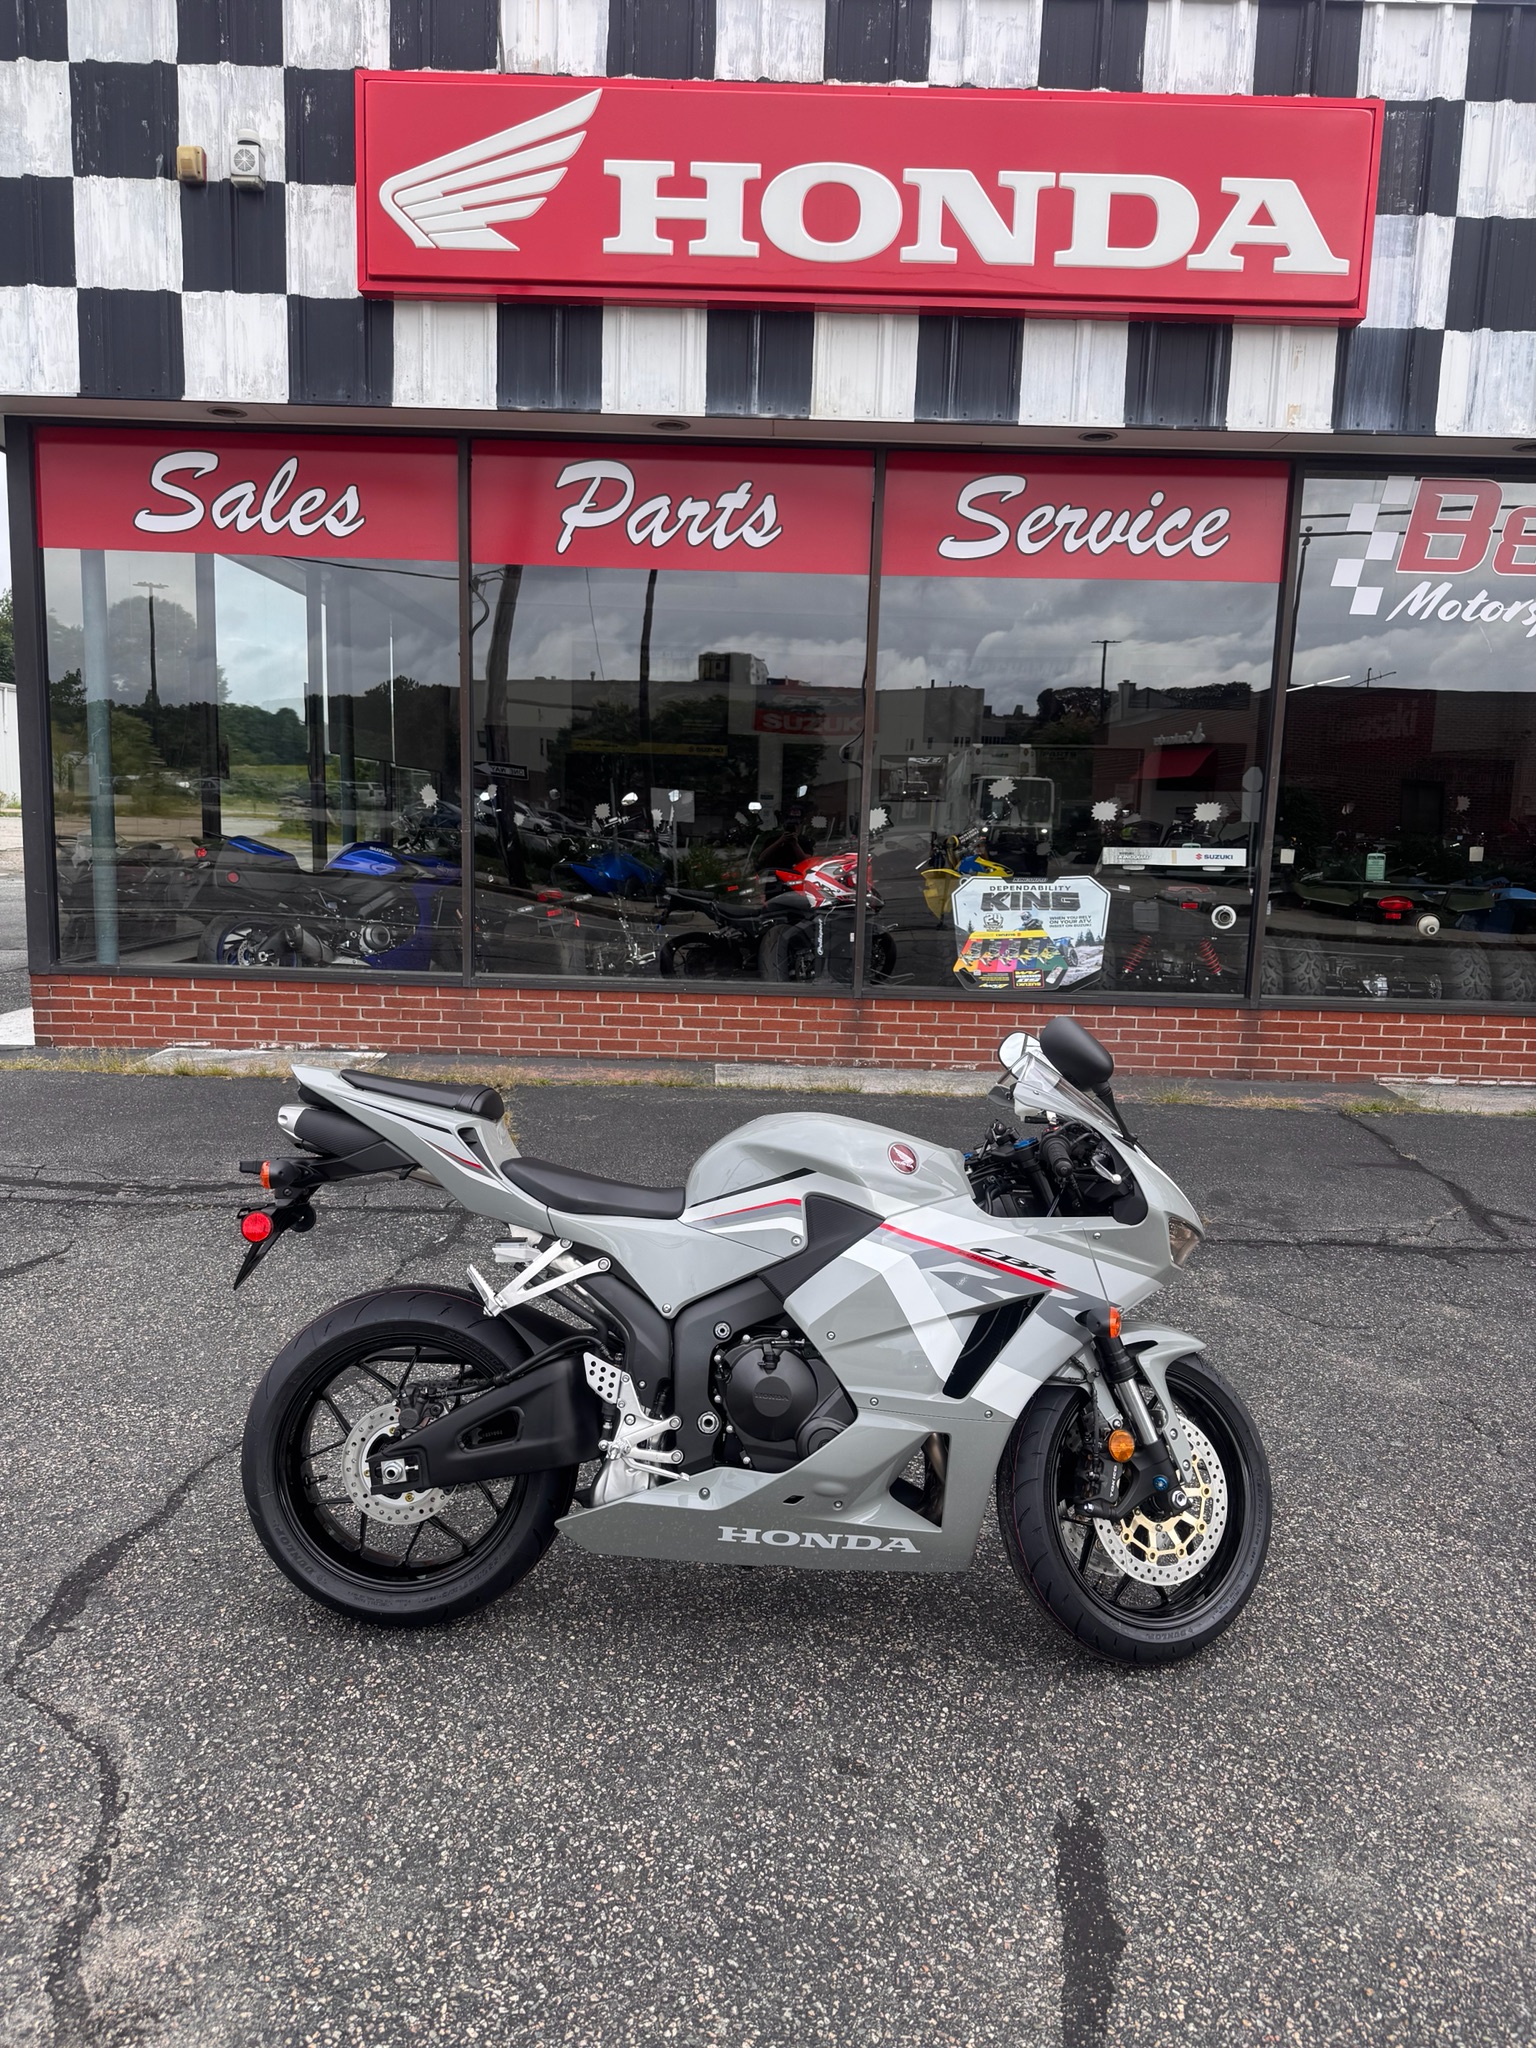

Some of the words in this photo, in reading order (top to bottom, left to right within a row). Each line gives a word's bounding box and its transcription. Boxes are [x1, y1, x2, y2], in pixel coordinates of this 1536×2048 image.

[603, 158, 1350, 275] HONDA
[133, 449, 366, 538] Sales
[555, 458, 783, 555] Parts
[938, 474, 1231, 559] Service
[1386, 580, 1536, 637] Motors
[761, 712, 866, 733] SUZUK
[369, 845, 393, 857] SUZUKI
[980, 891, 1081, 912] KING
[986, 912, 1002, 923] 24
[969, 1246, 1057, 1281] CBR
[753, 1392, 790, 1402] HONDA
[1109, 1465, 1118, 1498] TOKICO
[274, 1524, 318, 1575] DUNLOP
[717, 1524, 921, 1554] HONDA
[1147, 1629, 1187, 1641] DUNLOP
